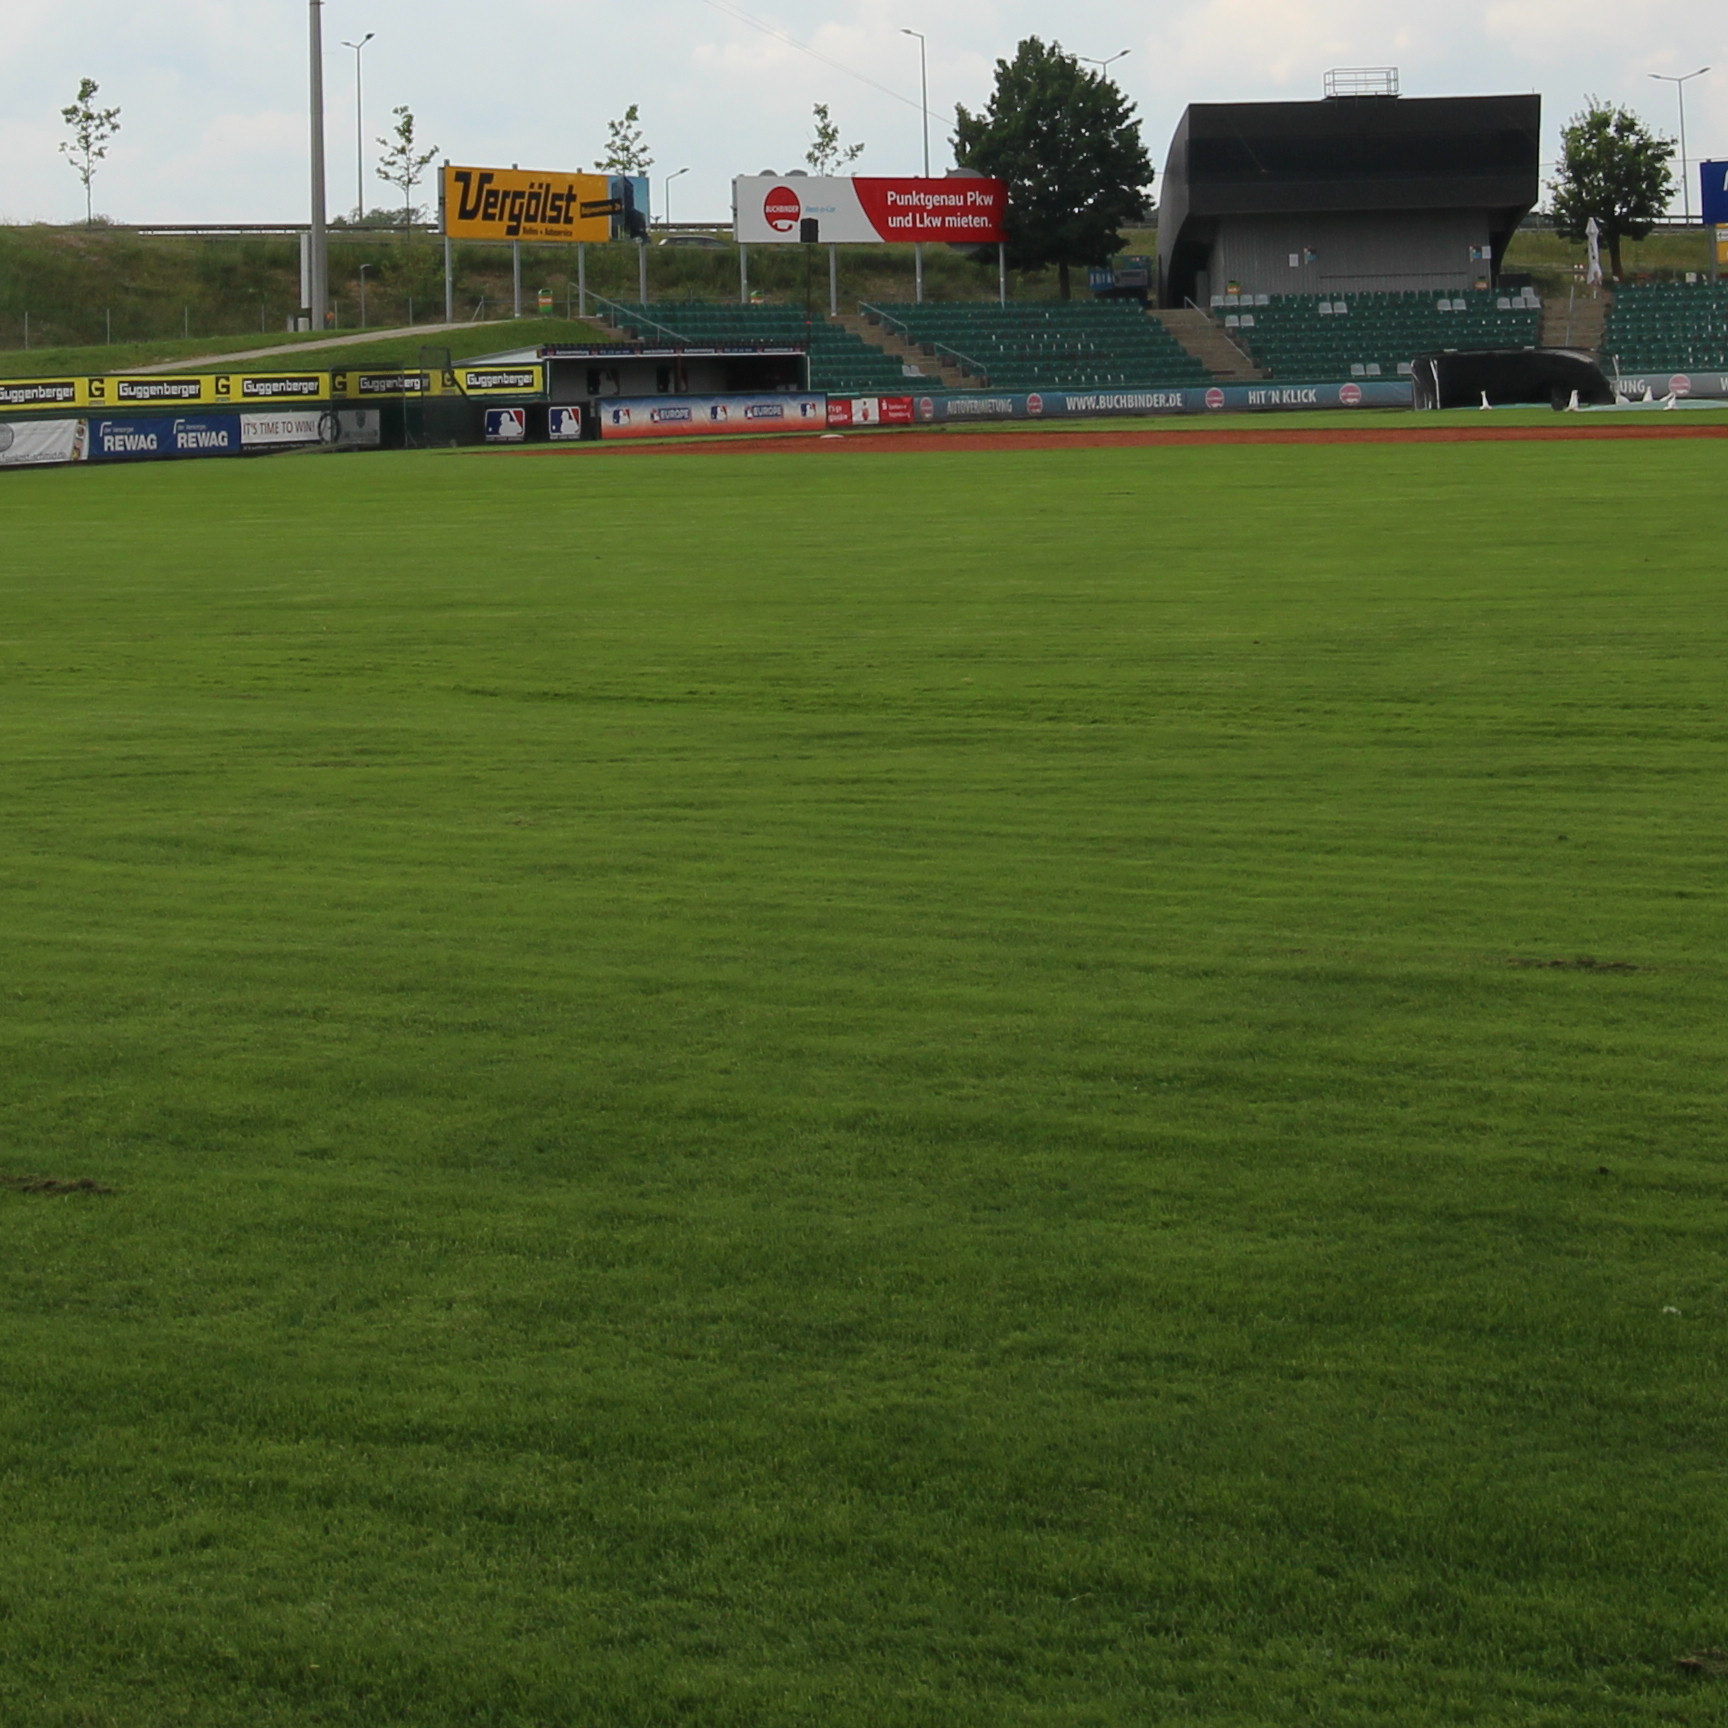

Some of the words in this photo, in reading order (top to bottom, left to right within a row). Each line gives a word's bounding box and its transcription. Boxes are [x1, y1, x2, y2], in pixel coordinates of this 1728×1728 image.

[454, 171, 577, 236] Vergölst
[887, 190, 964, 210] Punktgenau
[967, 192, 994, 206] Pkw
[888, 214, 913, 228] und
[916, 214, 941, 228] Lkw
[945, 213, 993, 228] mieten.
[243, 379, 319, 396] Guggenberger
[466, 373, 534, 389] Guggenberger
[119, 382, 200, 399] Guggenberger
[1248, 391, 1264, 404] HIT
[1282, 389, 1317, 403] KLICK
[1066, 393, 1182, 411] WWW.BUCHBINDER.DE
[661, 408, 690, 421] EUROPE
[754, 405, 781, 417] EUROPE
[243, 422, 257, 435] IT'S
[260, 422, 279, 435] TIME
[282, 422, 292, 433] TO
[294, 421, 315, 433] WIN!
[104, 434, 157, 451] REWAG
[178, 431, 228, 448] REWAG
